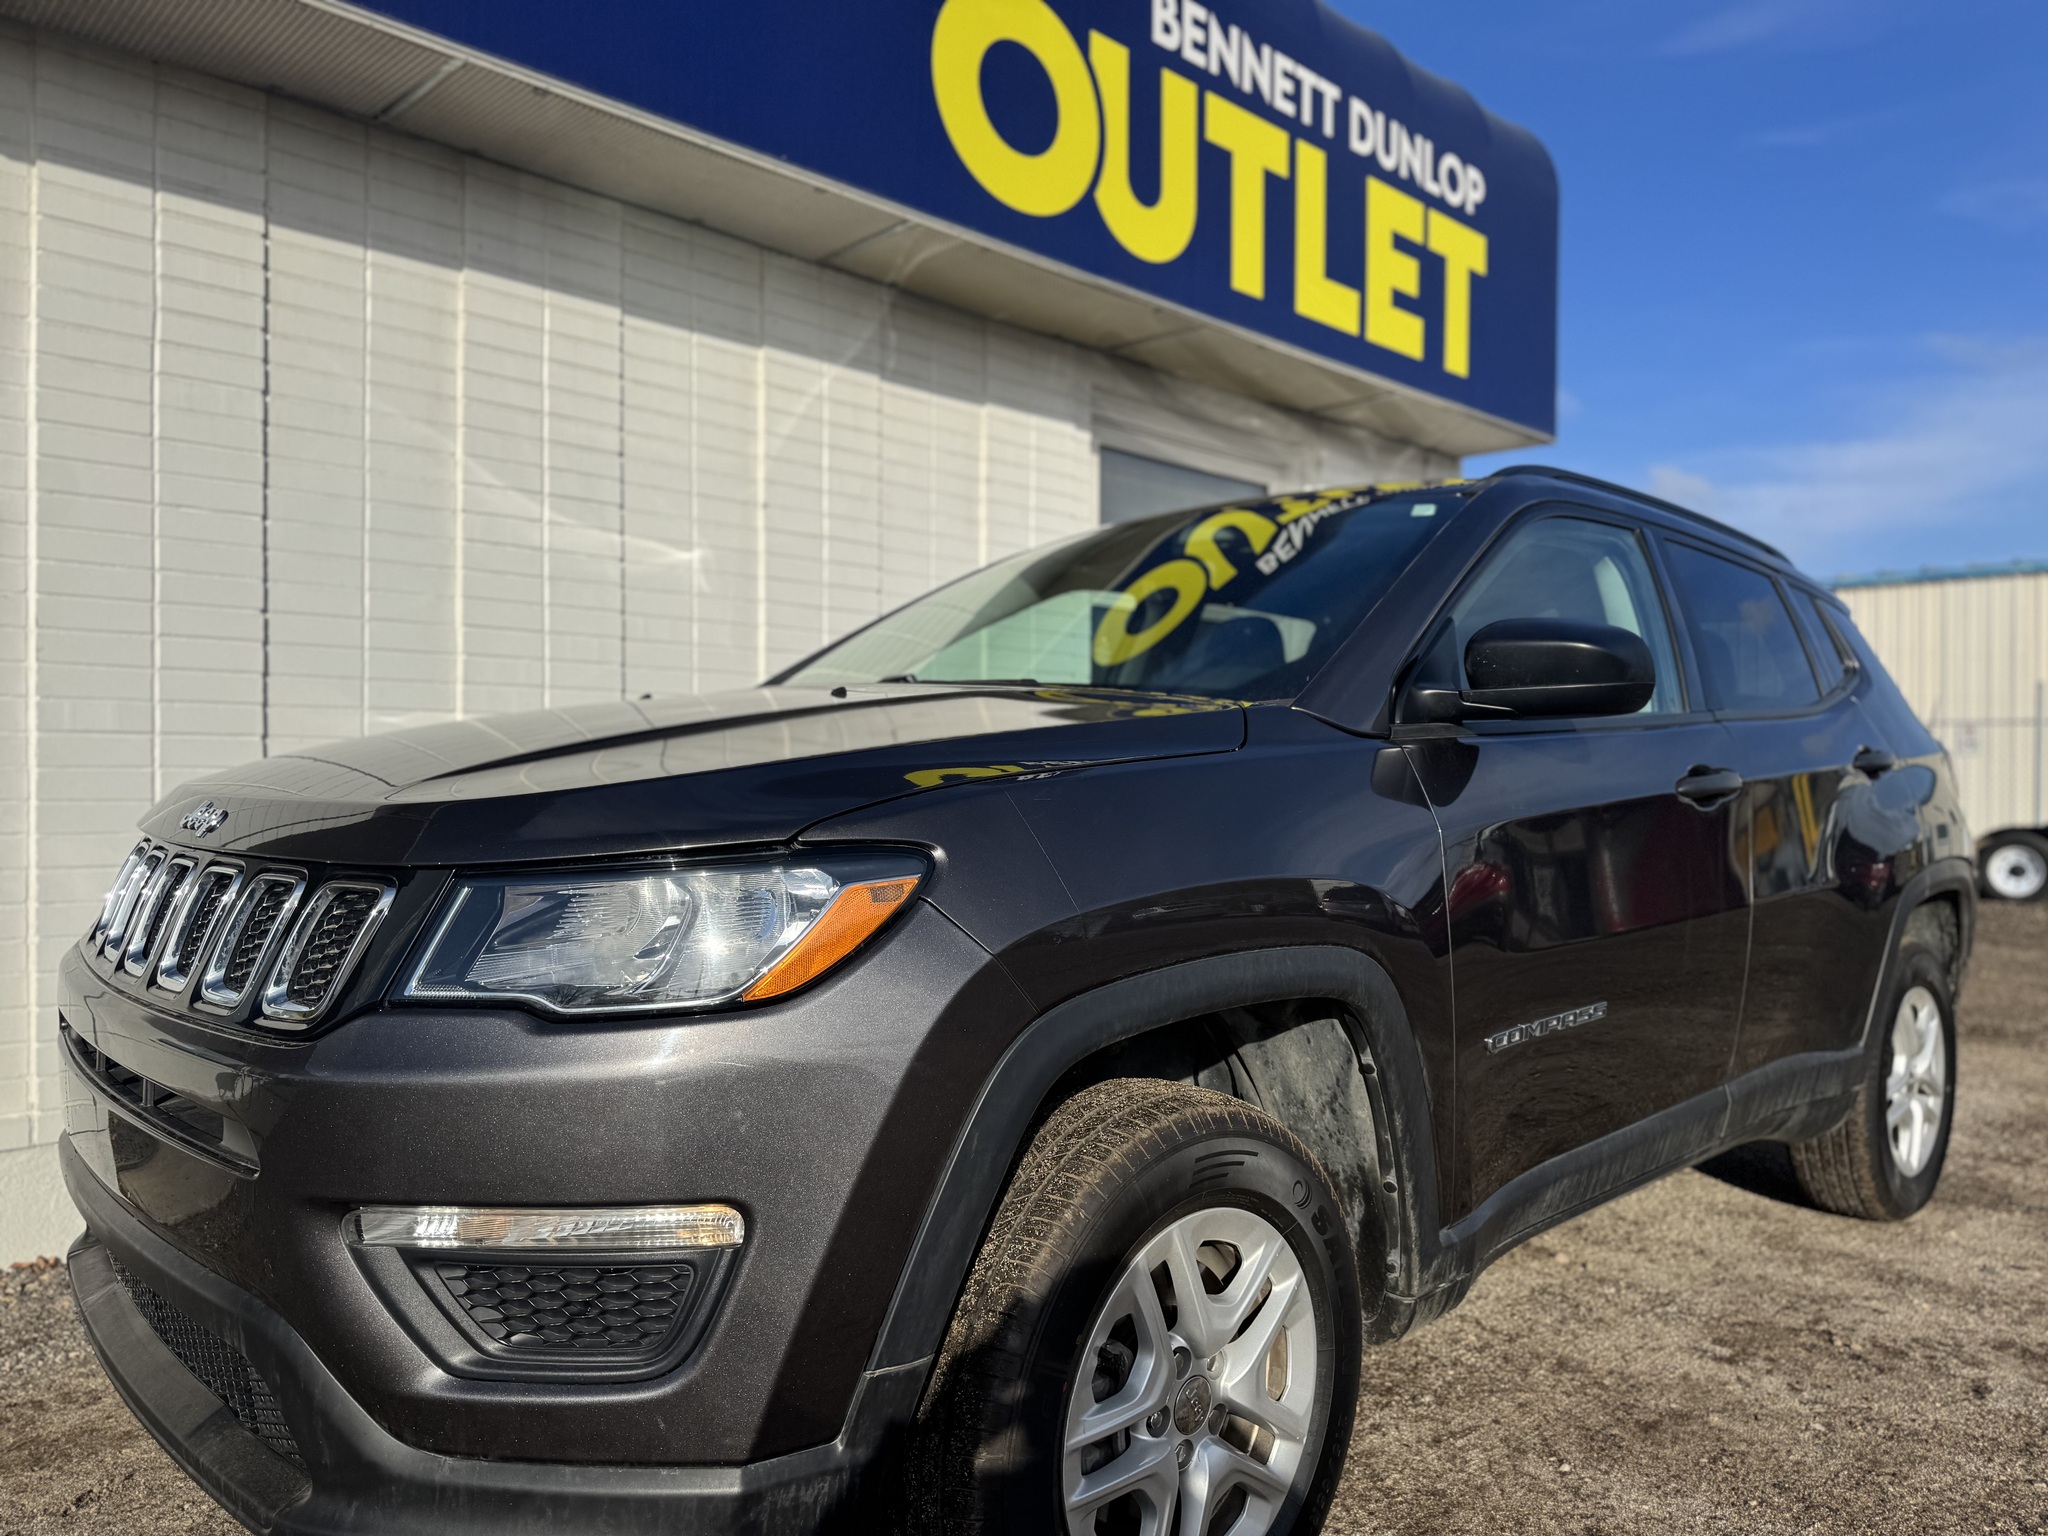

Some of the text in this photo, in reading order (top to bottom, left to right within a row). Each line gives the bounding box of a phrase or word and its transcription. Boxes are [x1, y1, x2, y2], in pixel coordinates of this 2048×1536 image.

[1151, 0, 1487, 216] BENNETT DUNLOP
[931, 0, 1488, 378] OUTLET
[180, 800, 229, 838] Jeep
[1484, 1001, 1608, 1054] COMPASS
